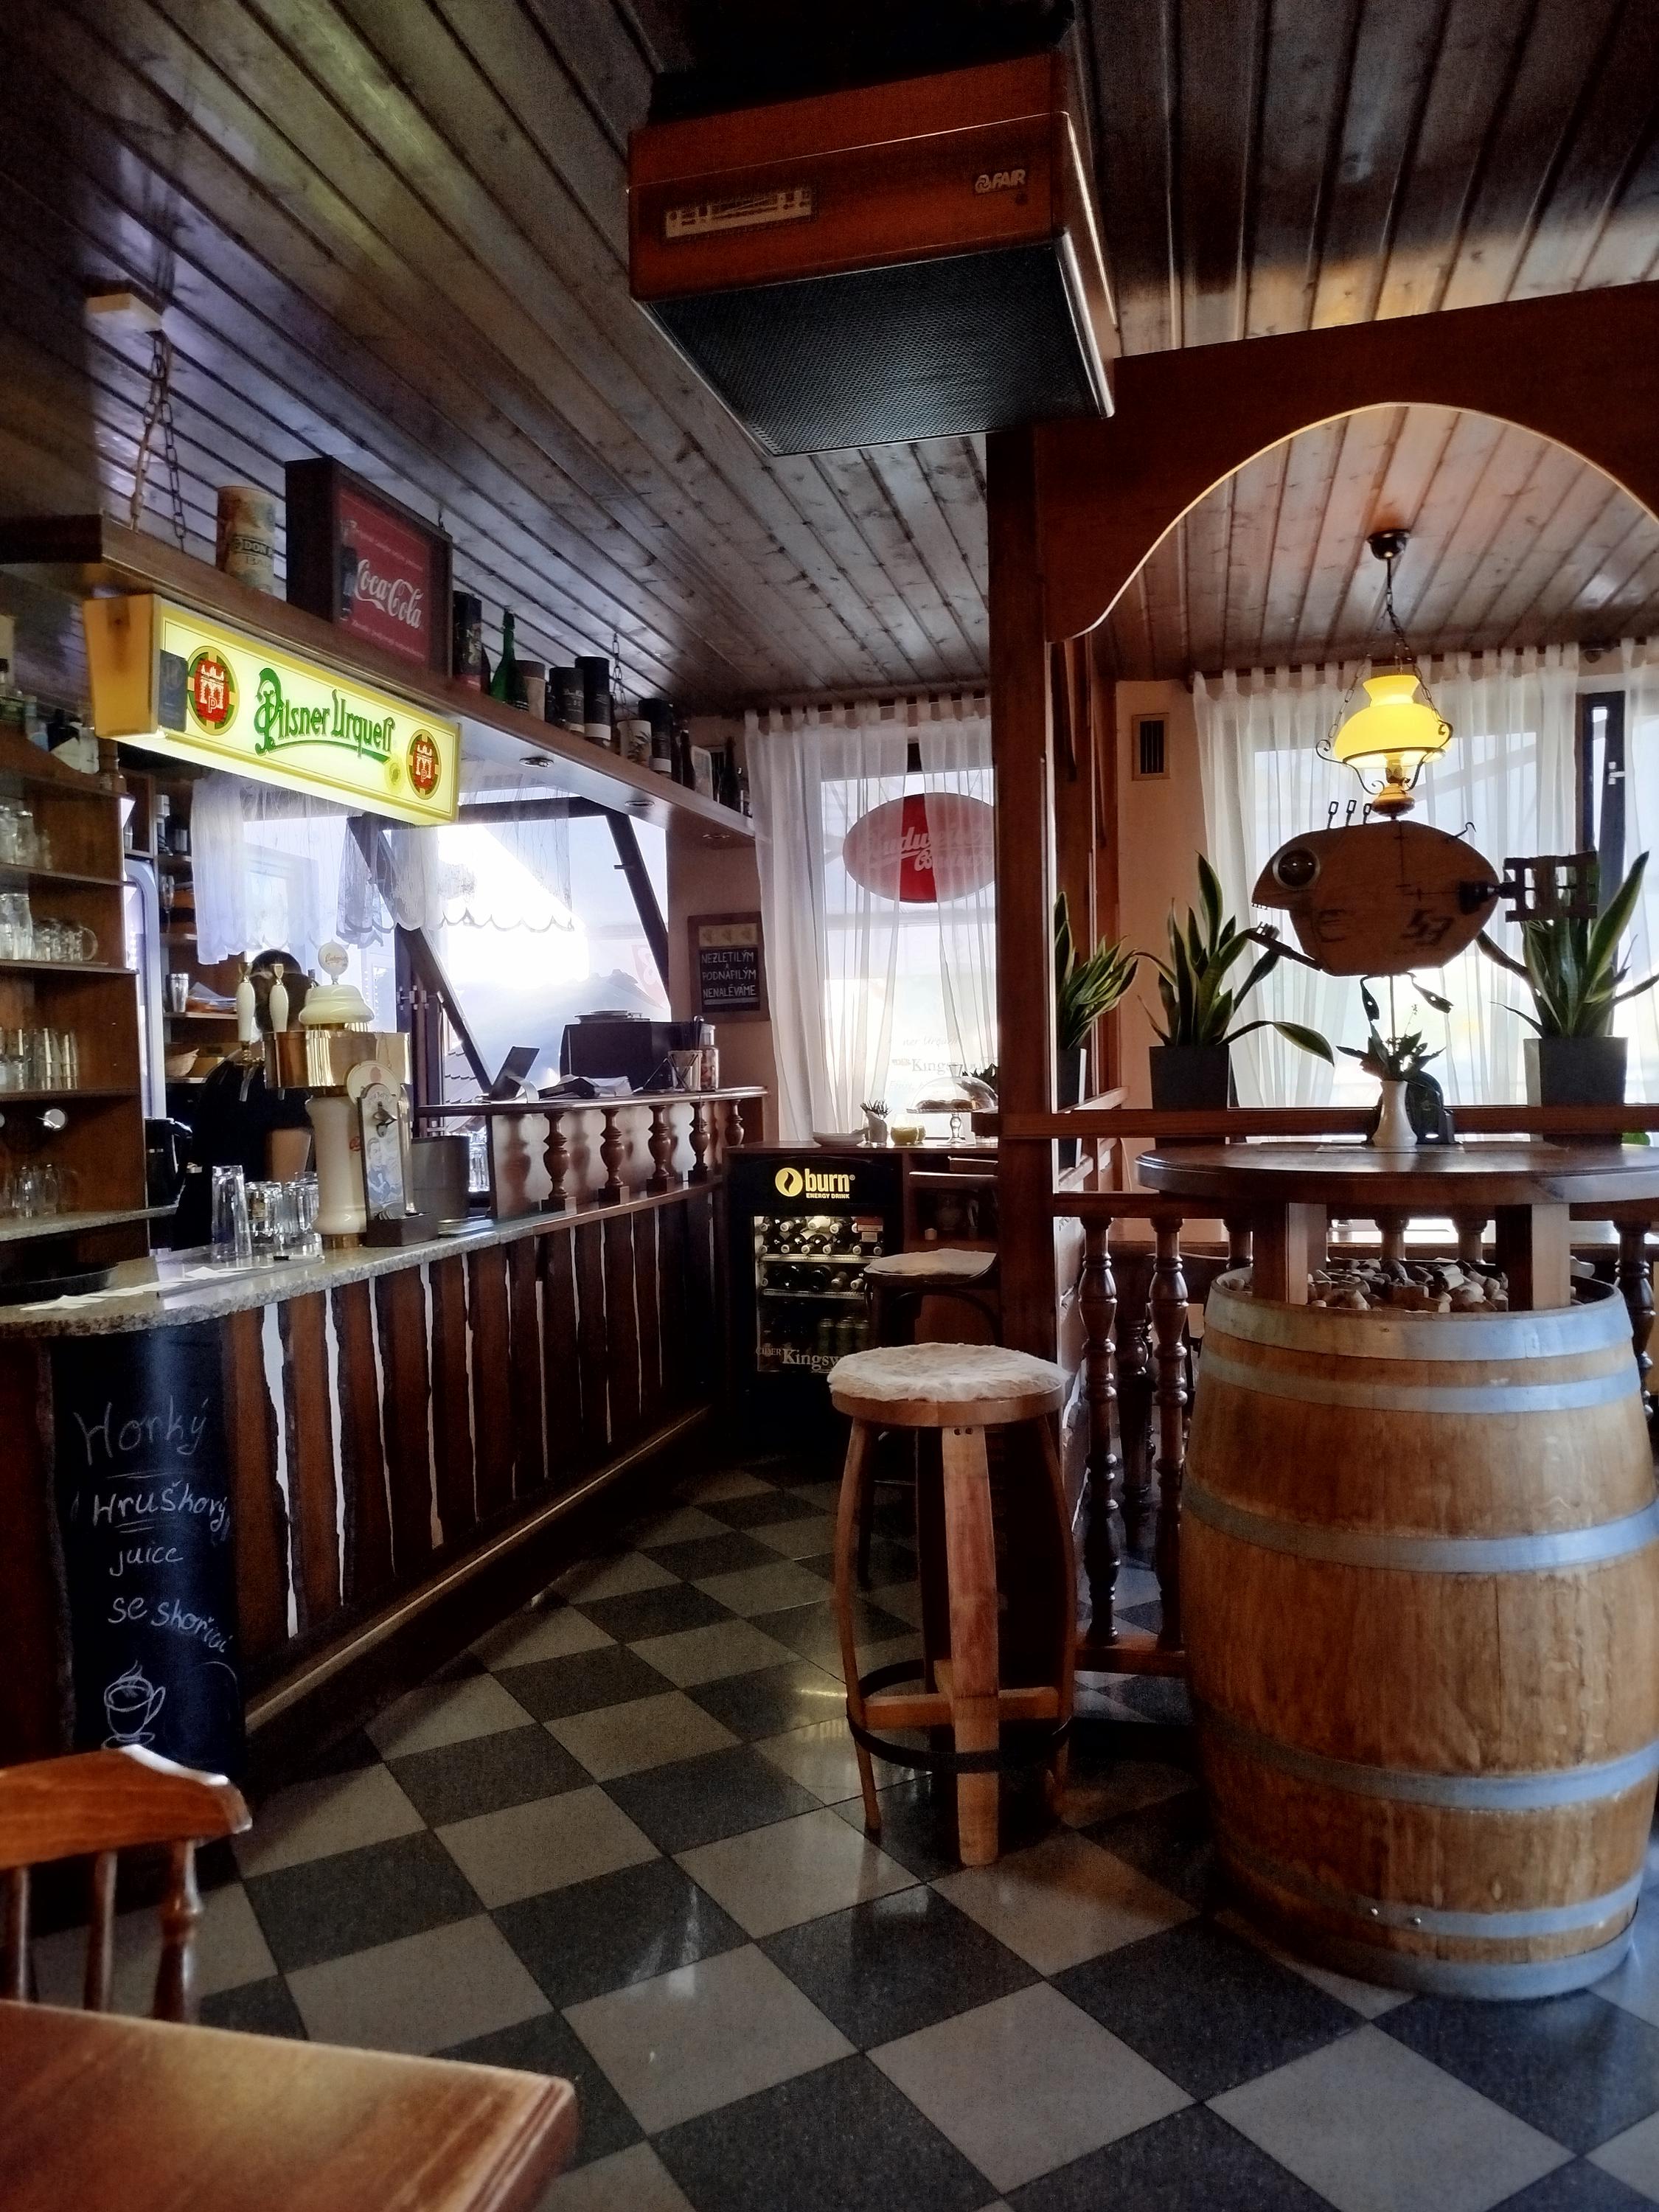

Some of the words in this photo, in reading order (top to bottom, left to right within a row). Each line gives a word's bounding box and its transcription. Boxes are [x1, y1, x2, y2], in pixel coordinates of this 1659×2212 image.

[354, 559, 423, 629] Coca-Cola
[254, 667, 330, 757] Pilsner
[331, 689, 396, 759] Urquell
[701, 950, 754, 964] NEZLETILÝM
[702, 967, 757, 981] PODNAPILÝM
[703, 984, 757, 999] NENALÉVÁME
[804, 1168, 850, 1192] burn
[782, 1348, 842, 1371] Kingsw
[73, 1394, 209, 1467] Horký
[109, 1542, 184, 1576] juice
